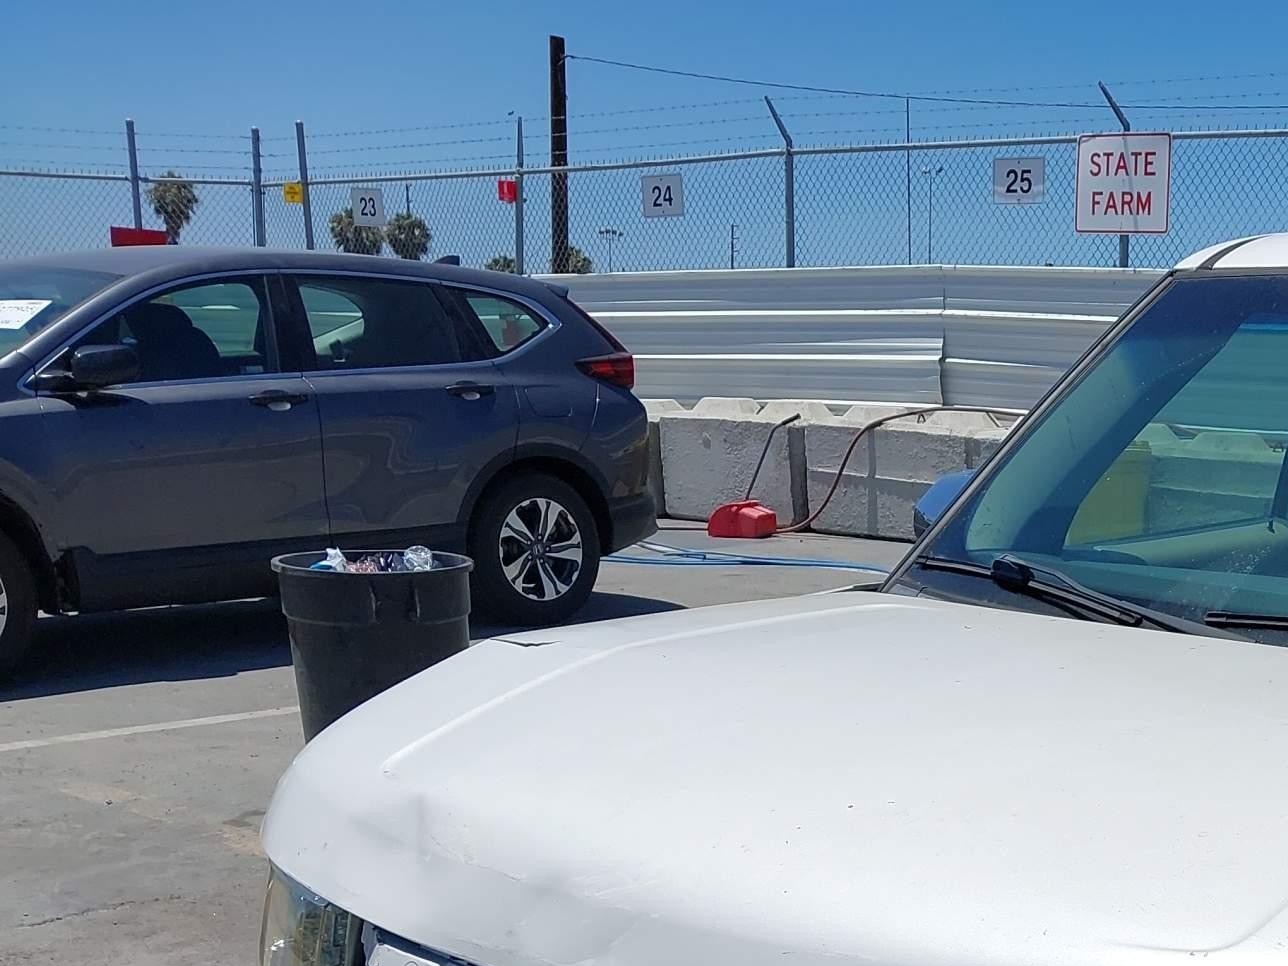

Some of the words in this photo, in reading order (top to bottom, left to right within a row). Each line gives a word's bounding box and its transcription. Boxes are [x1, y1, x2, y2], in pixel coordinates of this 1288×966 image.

[1089, 152, 1157, 177] STATE
[1005, 169, 1033, 194] 25
[359, 197, 377, 217] 23
[651, 185, 674, 208] 24
[1091, 191, 1152, 216] FARM
